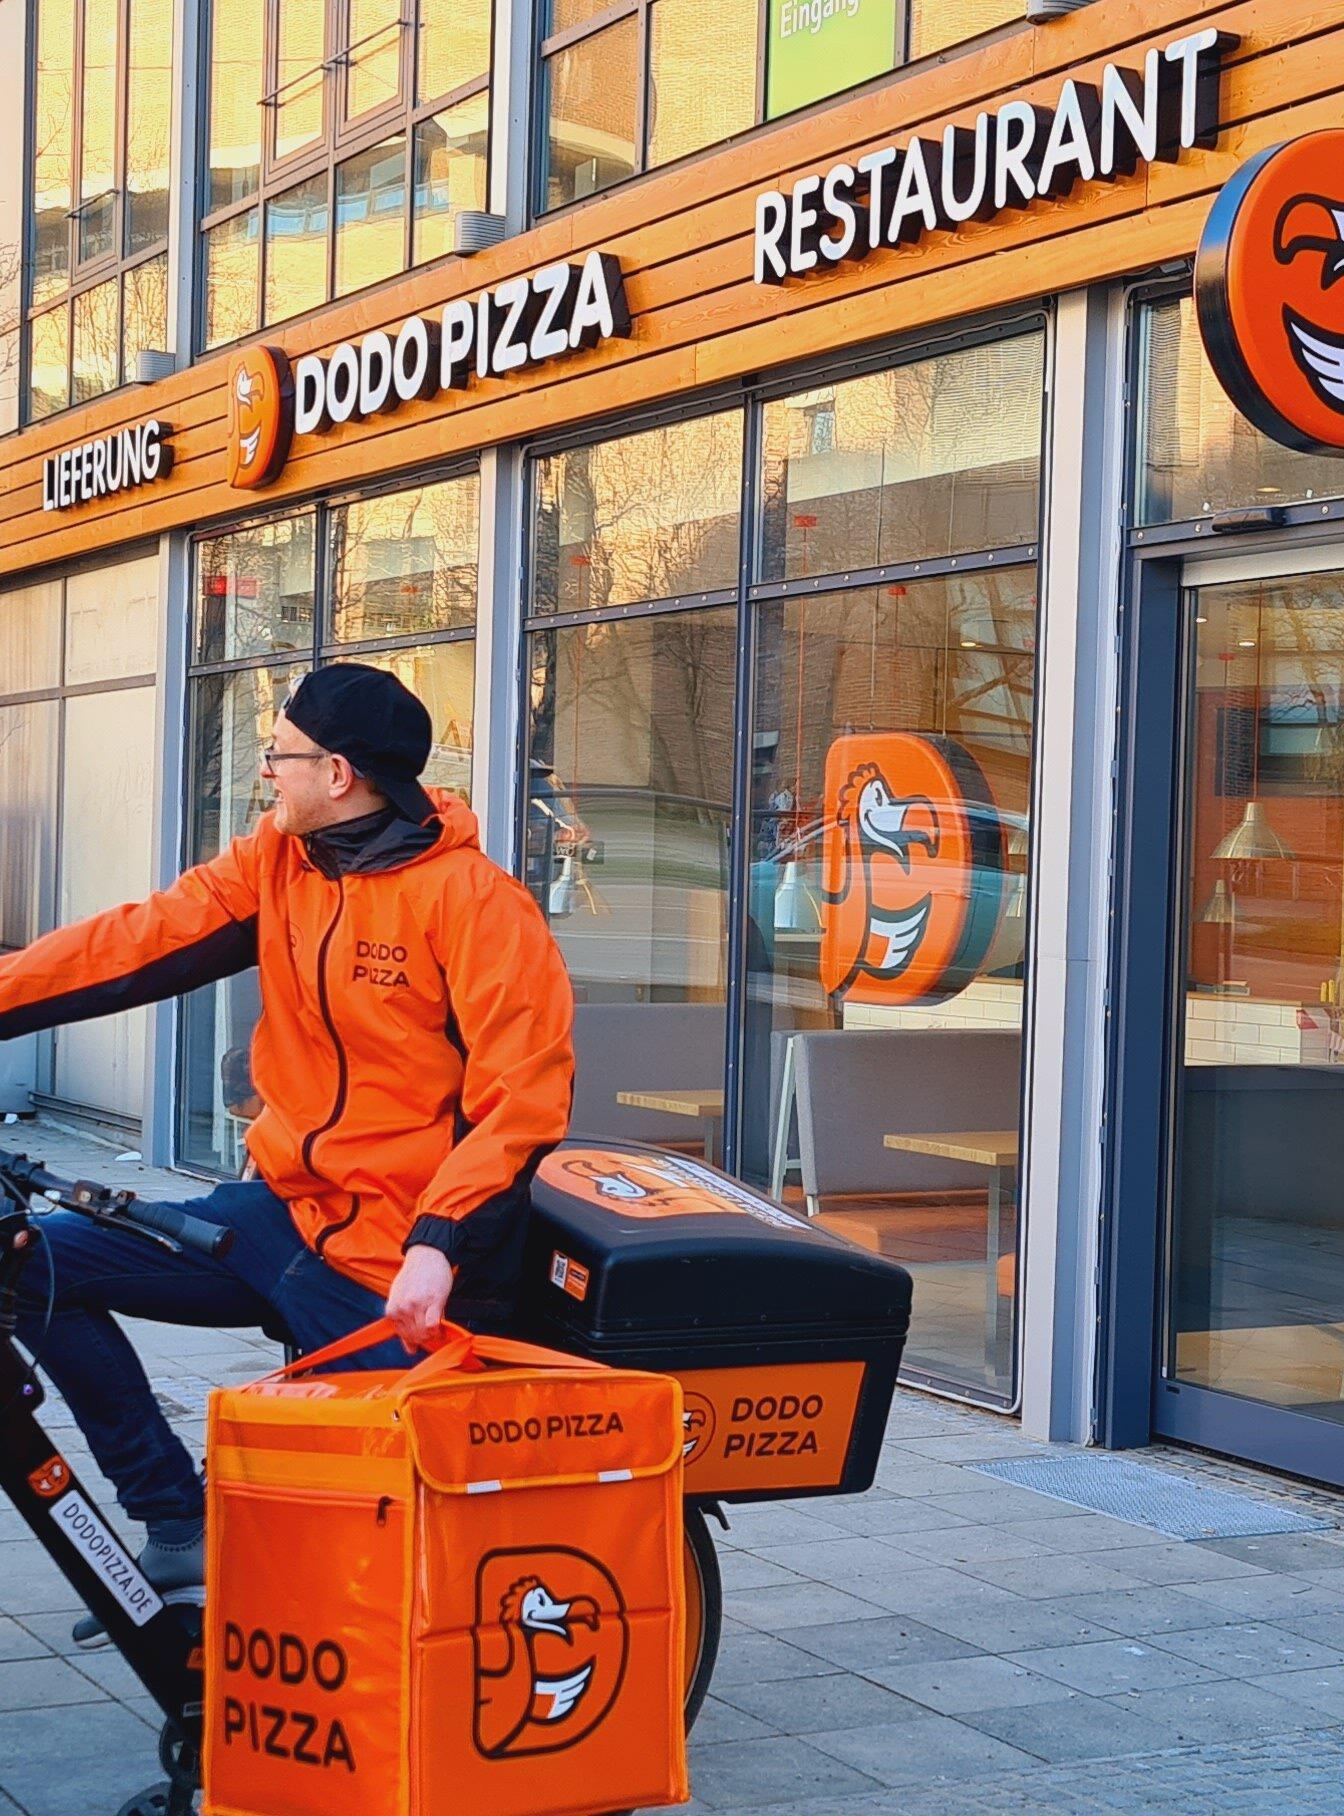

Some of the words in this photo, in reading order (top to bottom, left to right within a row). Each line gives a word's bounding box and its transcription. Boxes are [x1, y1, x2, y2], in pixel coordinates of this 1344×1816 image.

[755, 27, 1220, 284] RESTAURANT
[296, 315, 428, 434] DODO
[440, 250, 614, 389] PIZZA
[42, 420, 161, 510] LIEFERUNG
[356, 940, 408, 963] DODO
[468, 1416, 542, 1446] DODO
[546, 1411, 625, 1440] PIZZA
[723, 1429, 819, 1460] PIZZA
[729, 1395, 825, 1423] DODO
[63, 1502, 154, 1614] DODOPIZZA.DE
[223, 1621, 348, 1692] DODO
[224, 1696, 356, 1772] PIZZA
